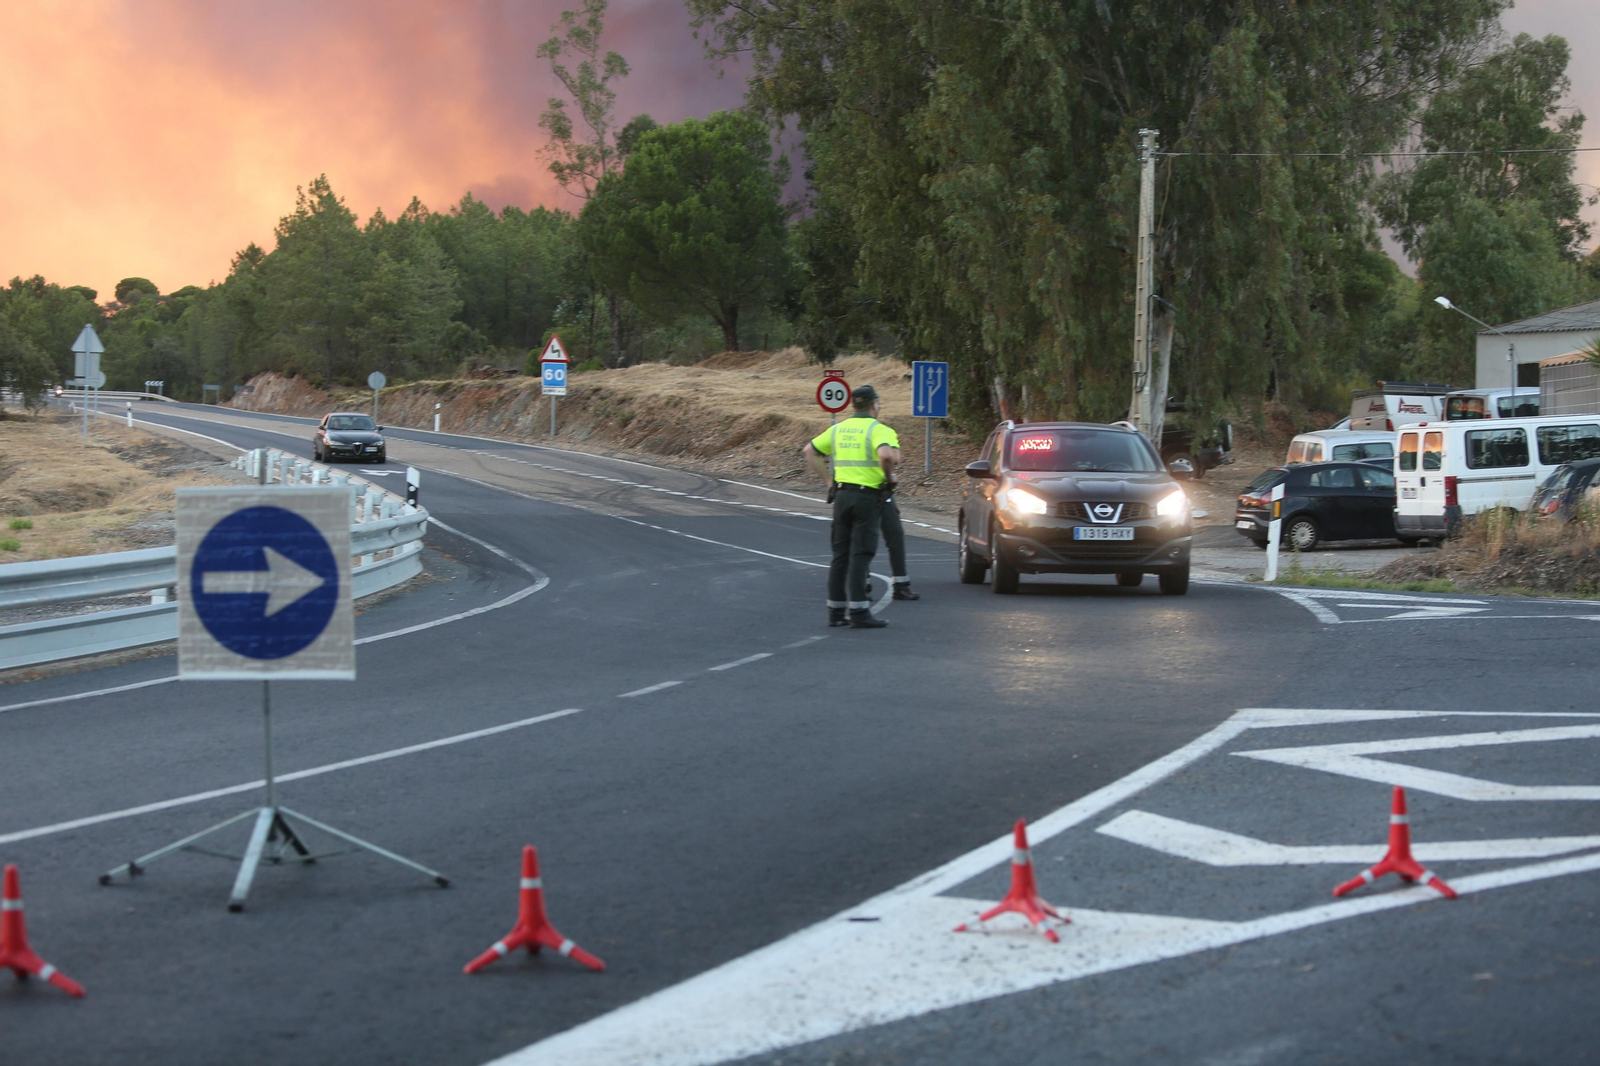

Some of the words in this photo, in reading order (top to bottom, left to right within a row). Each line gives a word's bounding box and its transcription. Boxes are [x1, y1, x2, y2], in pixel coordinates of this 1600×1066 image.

[545, 369, 564, 381] 60
[825, 389, 844, 401] 90
[1083, 529, 1109, 538] 1319
[1111, 529, 1132, 538] HXY
